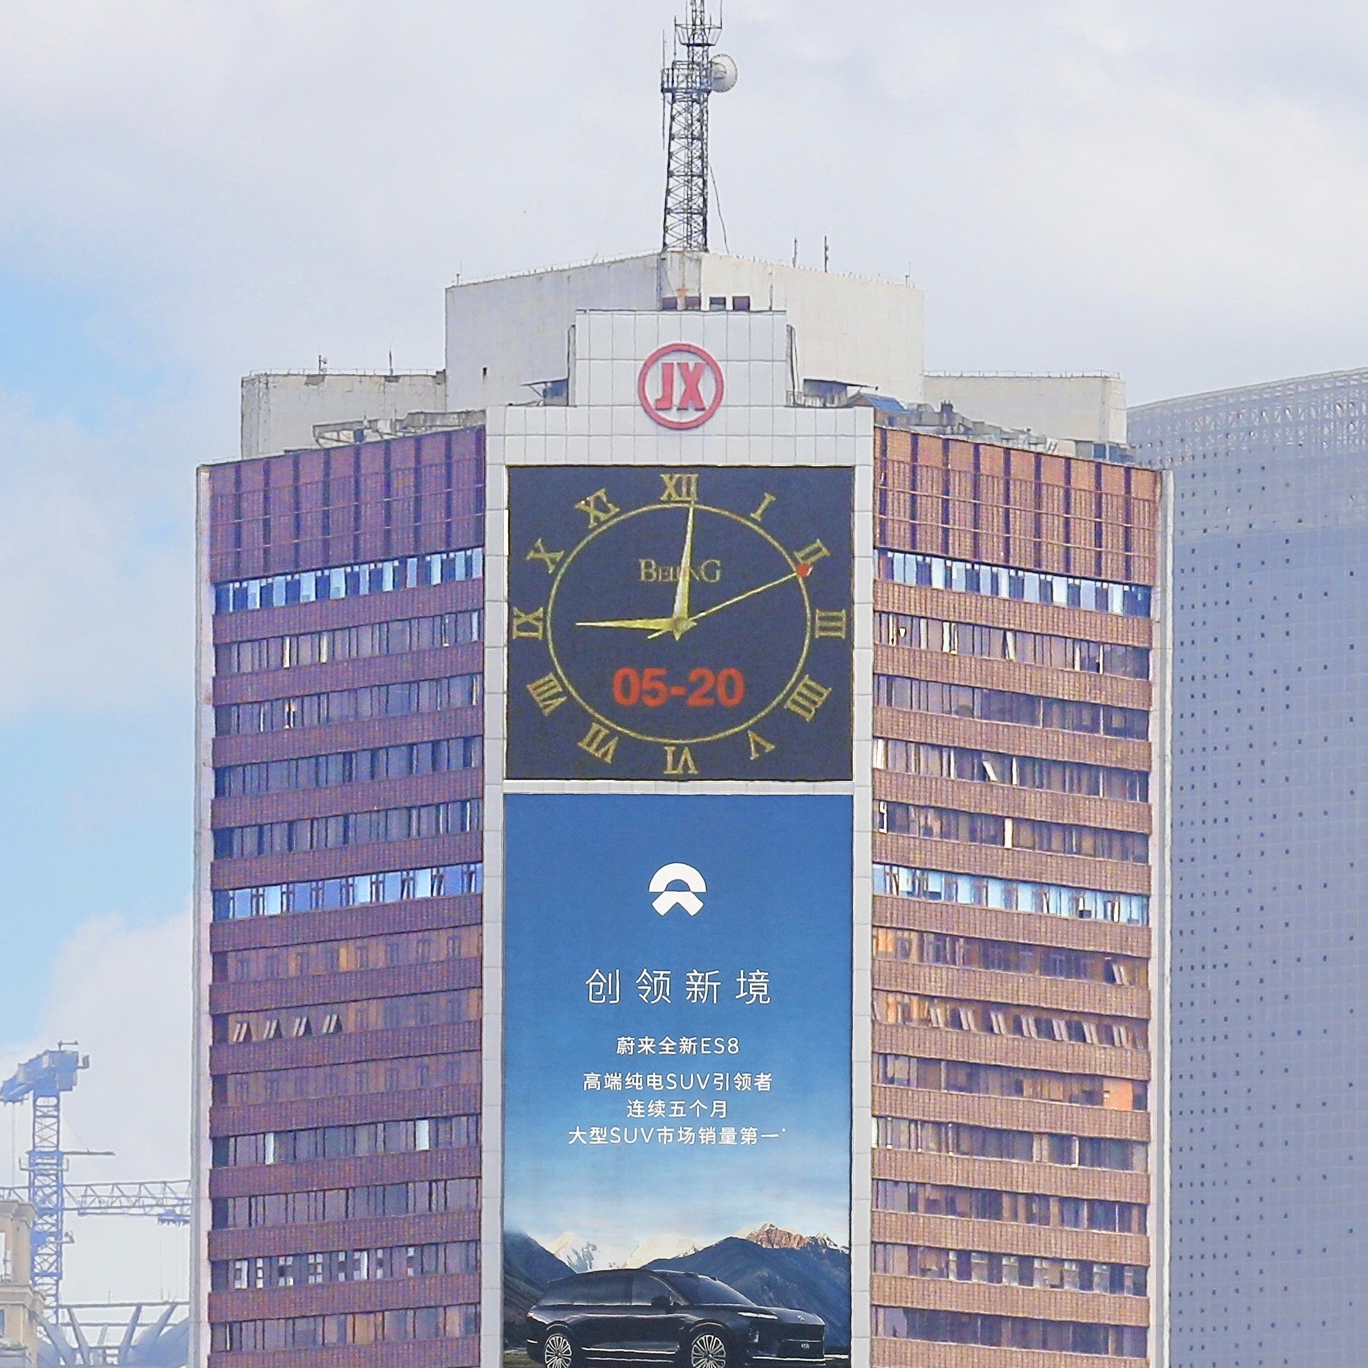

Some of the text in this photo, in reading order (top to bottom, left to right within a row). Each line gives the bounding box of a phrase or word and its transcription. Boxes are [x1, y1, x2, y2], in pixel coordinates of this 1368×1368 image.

[612, 668, 745, 707] 05-20
[584, 968, 772, 1005] 创领新境
[615, 1036, 740, 1055] 蔚来全新ES8
[582, 1072, 774, 1092] 高端纯电SUV引领者
[626, 1099, 729, 1119] 连续五个月
